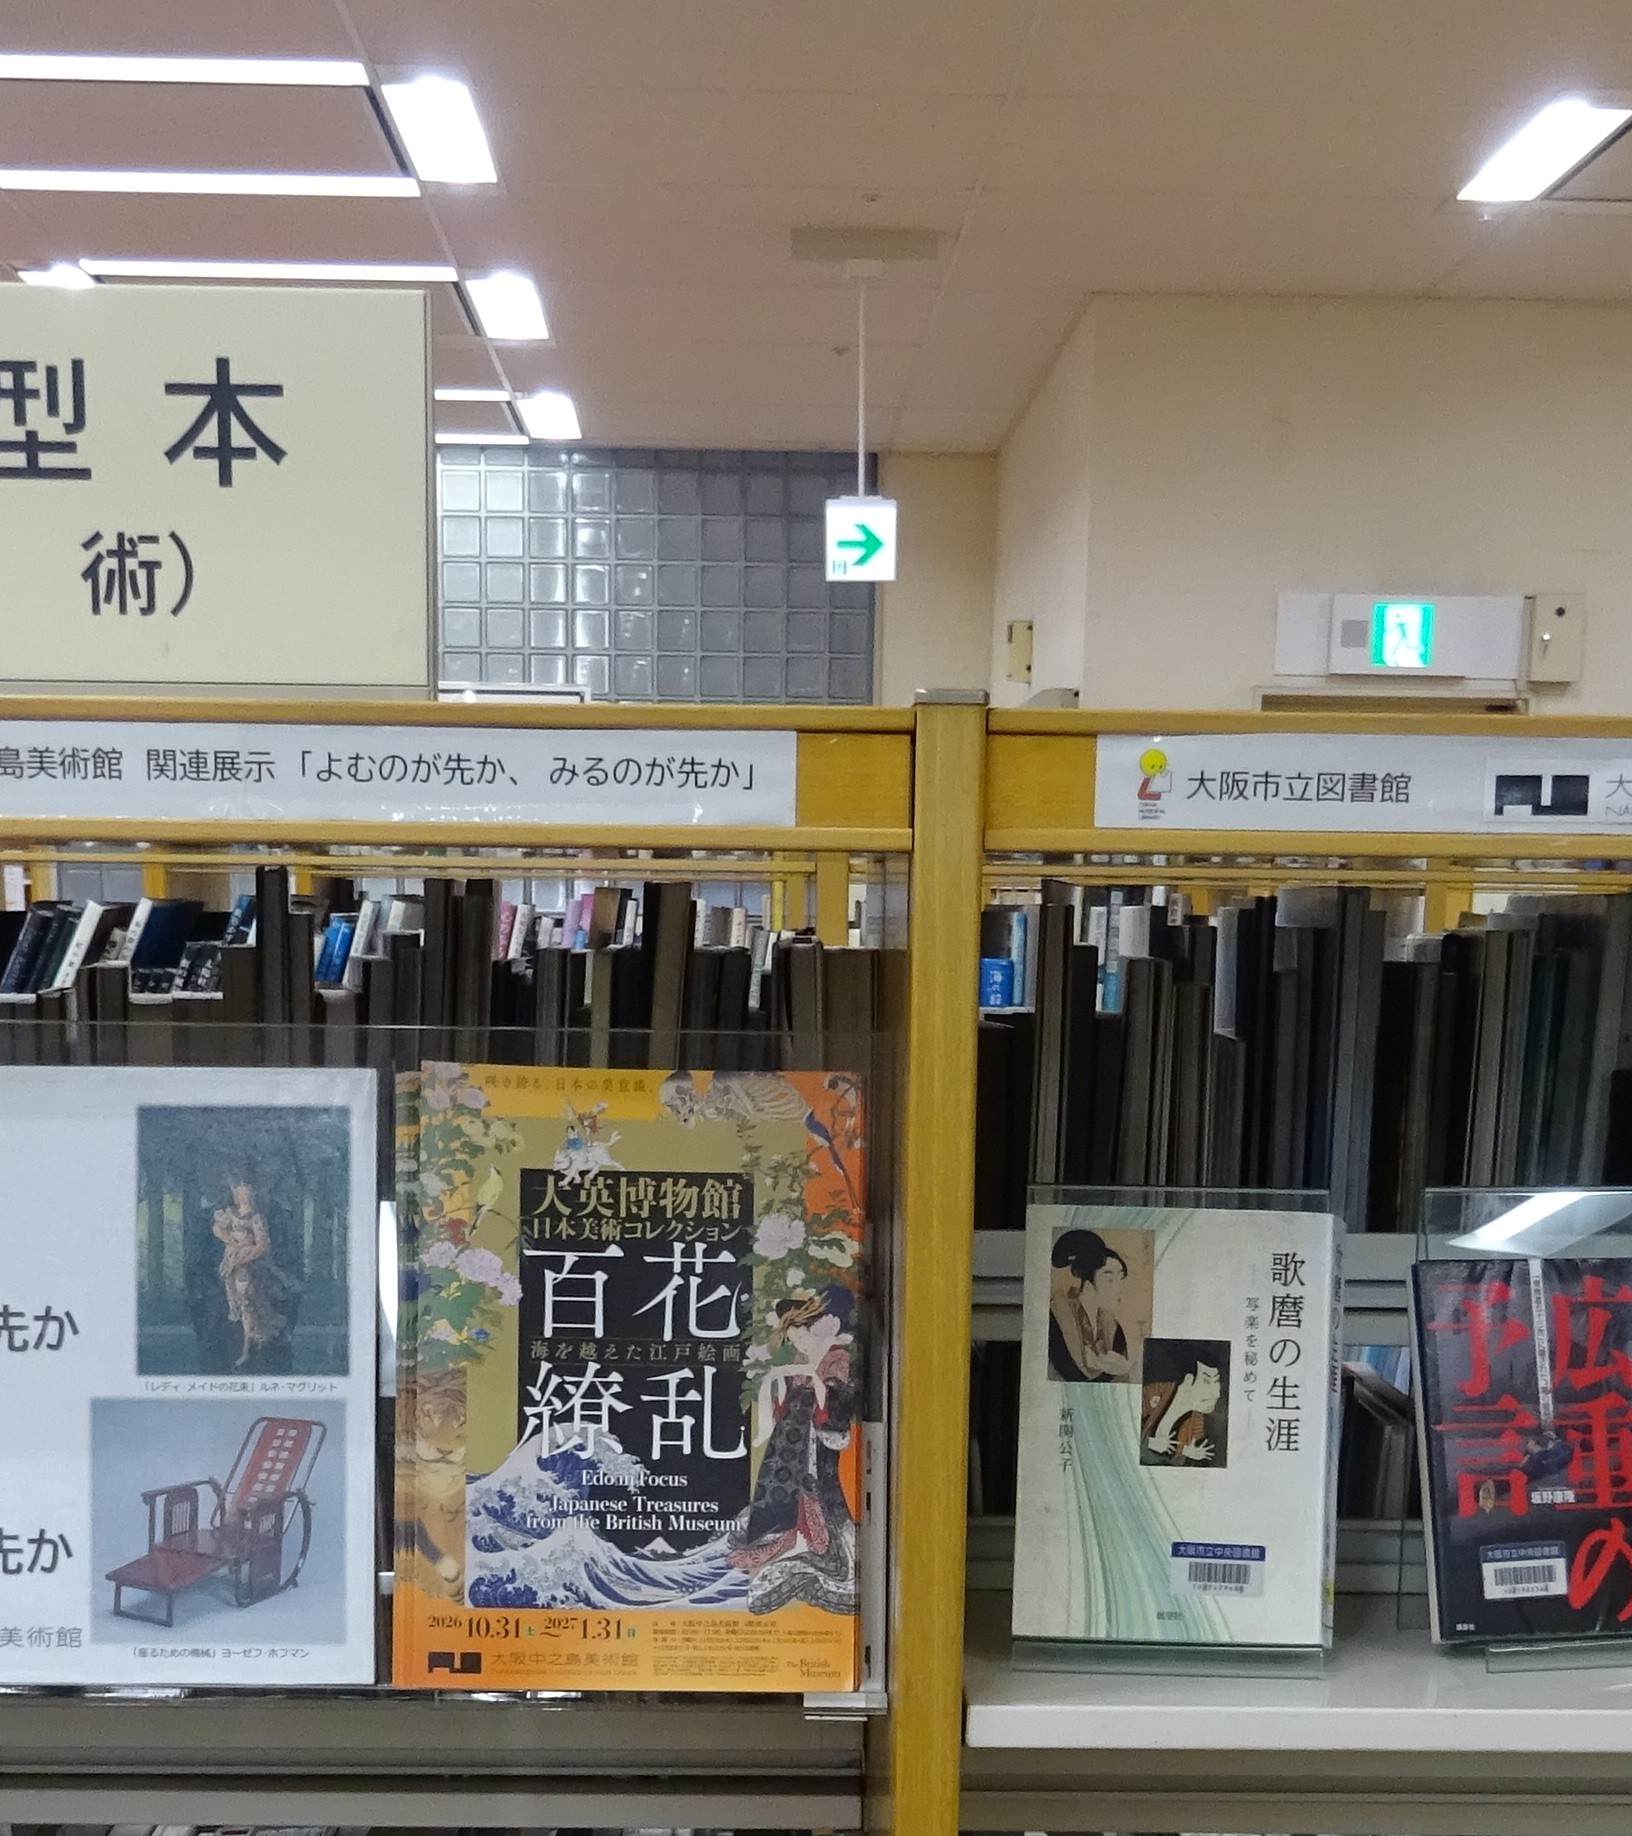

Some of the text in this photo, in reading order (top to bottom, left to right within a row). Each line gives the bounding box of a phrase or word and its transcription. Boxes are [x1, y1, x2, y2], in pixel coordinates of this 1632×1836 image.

[1186, 769, 1413, 804] 大阪市立図書館
[532, 1175, 743, 1220] 大英博物館
[531, 1217, 742, 1243] 日本美術コレクション
[522, 1243, 743, 1342] 百花
[529, 1342, 743, 1363] 海を越えた江戸絵画
[1264, 1251, 1306, 1453] 歌麿の生涯
[507, 1361, 749, 1461] 繚乱
[638, 1471, 689, 1488] Focus
[549, 1496, 720, 1514] Japanese Treasures
[605, 1514, 663, 1531] British
[667, 1515, 742, 1532] Museum
[427, 1615, 463, 1629] 2026
[465, 1616, 522, 1641] 10.31
